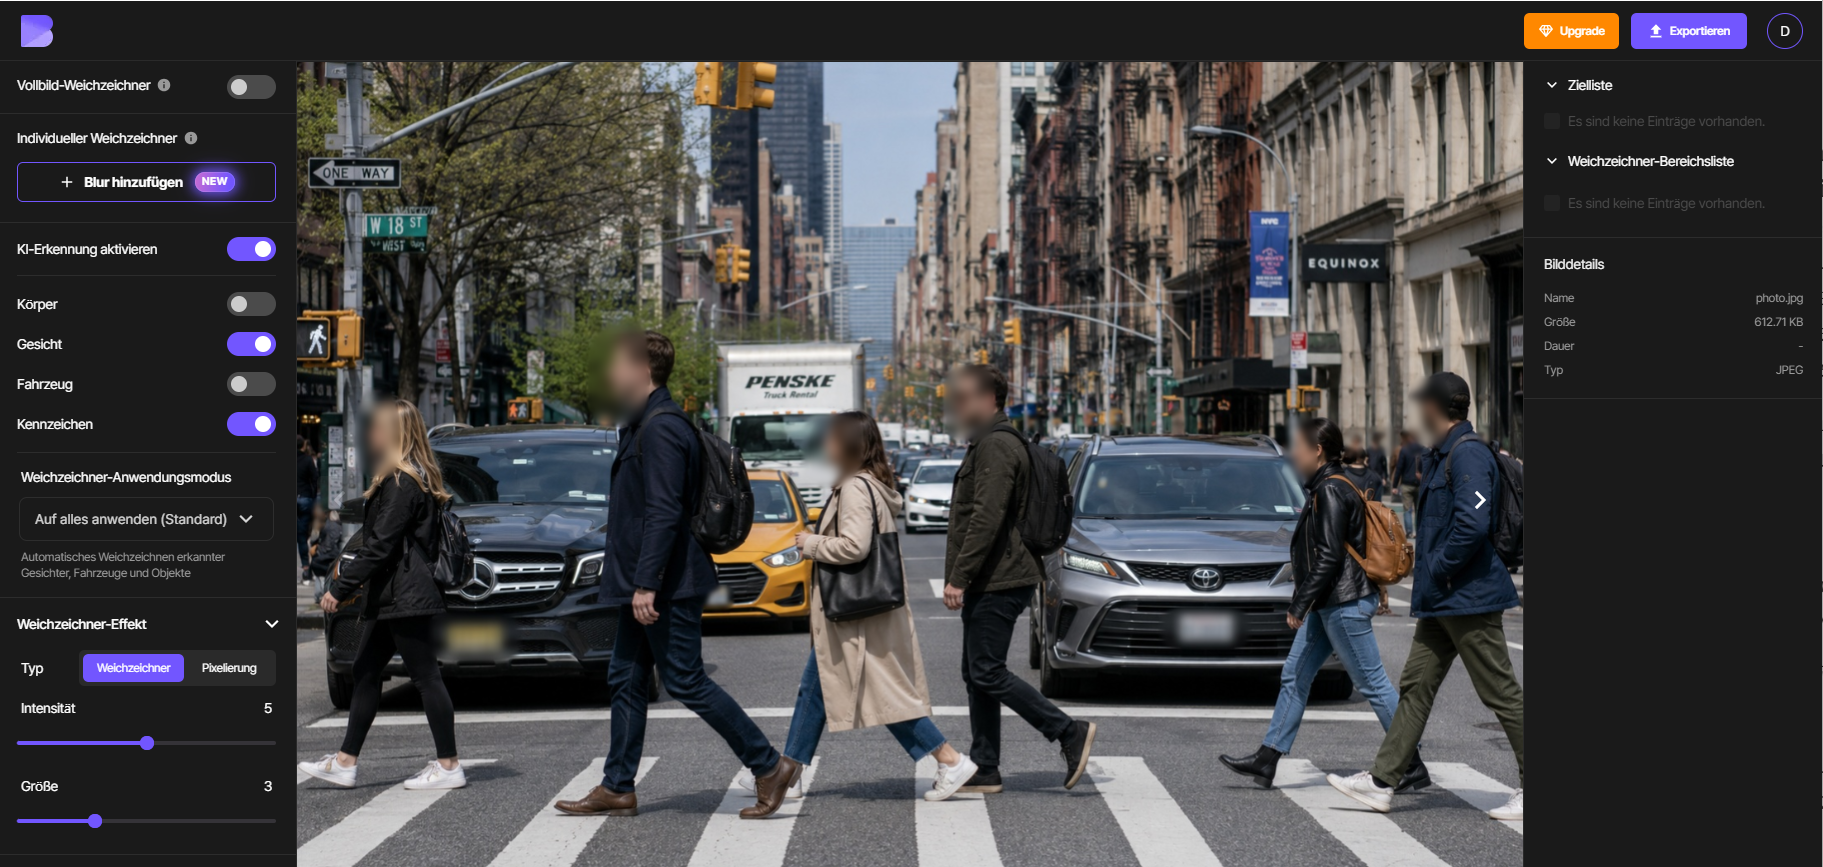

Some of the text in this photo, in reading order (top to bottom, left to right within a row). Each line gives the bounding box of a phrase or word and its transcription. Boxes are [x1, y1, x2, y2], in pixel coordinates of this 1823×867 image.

[1559, 25, 1606, 39] Upgrade
[1669, 25, 1731, 39] Exportieren
[1780, 25, 1791, 37] D
[16, 78, 152, 92] Vollbild-Weichzeichner
[1567, 78, 1614, 92] Zielliste
[1568, 115, 1766, 130] Es sind keine Einträge vorhanden.
[17, 131, 178, 145] Individueller Weichzeichner
[1567, 154, 1735, 168] Weichzeichner-Bereichsliste
[322, 167, 389, 179] ONE WAY
[84, 175, 184, 191] Blur hinzufügen
[201, 176, 228, 186] NEW
[1568, 197, 1766, 212] Es sind keine Einträge vorhanden.
[370, 216, 422, 235] W 18 ST
[1260, 217, 1279, 225] NYC
[17, 243, 158, 258] KI-Erkennung aktivieren
[1308, 257, 1380, 270] EQUINOX
[1544, 258, 1605, 271] Bilddetails
[1544, 292, 1575, 303] Name
[1755, 292, 1804, 306] photo.jpg
[17, 298, 59, 313] Körper
[1543, 316, 1576, 327] Größe
[1754, 316, 1804, 327] 612.71 KB
[16, 338, 63, 351] Gesicht
[1544, 340, 1575, 351] Dauer
[1544, 364, 1564, 378] Typ
[1775, 364, 1804, 375] JPEG
[17, 378, 74, 393] Fahrzeug
[745, 374, 836, 389] PENSKE
[764, 390, 819, 399] Truck Rental
[17, 417, 94, 431] Kennzeichen
[20, 470, 232, 486] Weichzeichner-Anwendungsmodus
[34, 512, 228, 528] Auf alles anwenden (Standard)
[20, 551, 226, 562] Automatisches Weichzeichnen erkannter
[20, 567, 192, 581] Gesichter, Fahrzeuge und Objekte
[16, 617, 148, 631] Weichzeichner-Effekt
[20, 662, 44, 677] Typ
[96, 662, 172, 674] Weichzeichner
[201, 662, 258, 676] Pixelierung
[21, 701, 77, 715] Intensität
[264, 702, 273, 714] 5
[20, 780, 59, 793] Größe
[263, 780, 273, 793] 3
